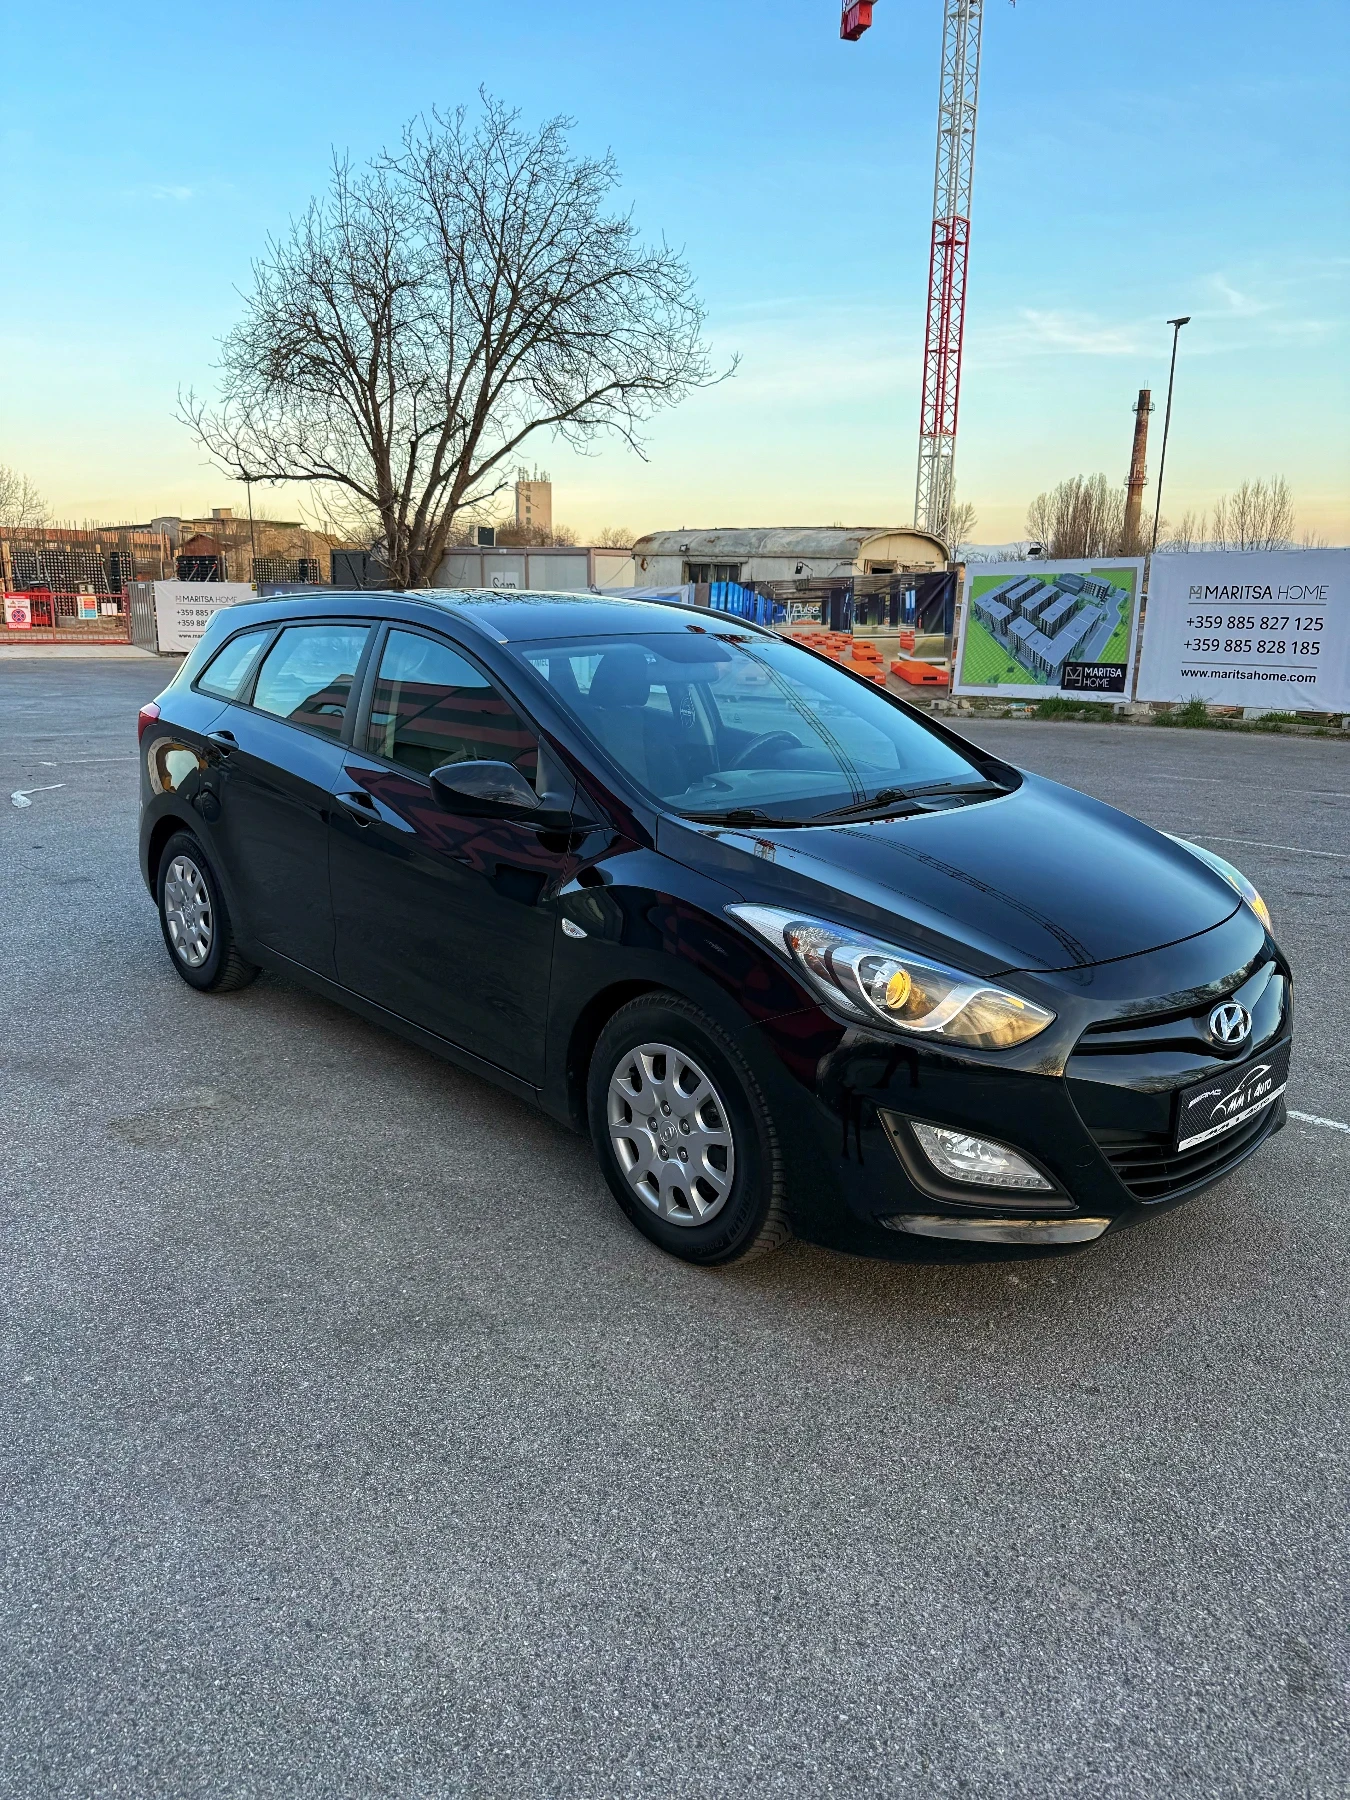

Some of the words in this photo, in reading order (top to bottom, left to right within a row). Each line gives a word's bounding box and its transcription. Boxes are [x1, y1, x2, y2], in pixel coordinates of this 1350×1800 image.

[1204, 585, 1273, 600] MARITSA
[1277, 584, 1330, 600] HOME
[182, 595, 214, 603] MARITSA
[195, 609, 209, 617] 885
[792, 602, 820, 614] Pulse
[1186, 615, 1223, 629] +359
[1226, 616, 1255, 630] 885
[1259, 616, 1290, 630] 827
[1294, 616, 1324, 631] 125
[1183, 638, 1220, 652] +359
[1223, 639, 1252, 653] 885
[1256, 639, 1286, 654] 828
[1291, 640, 1321, 655] 185
[1084, 667, 1122, 678] MARITSA
[1180, 668, 1317, 683] www.maritsahome.com
[1083, 678, 1110, 688] HOME
